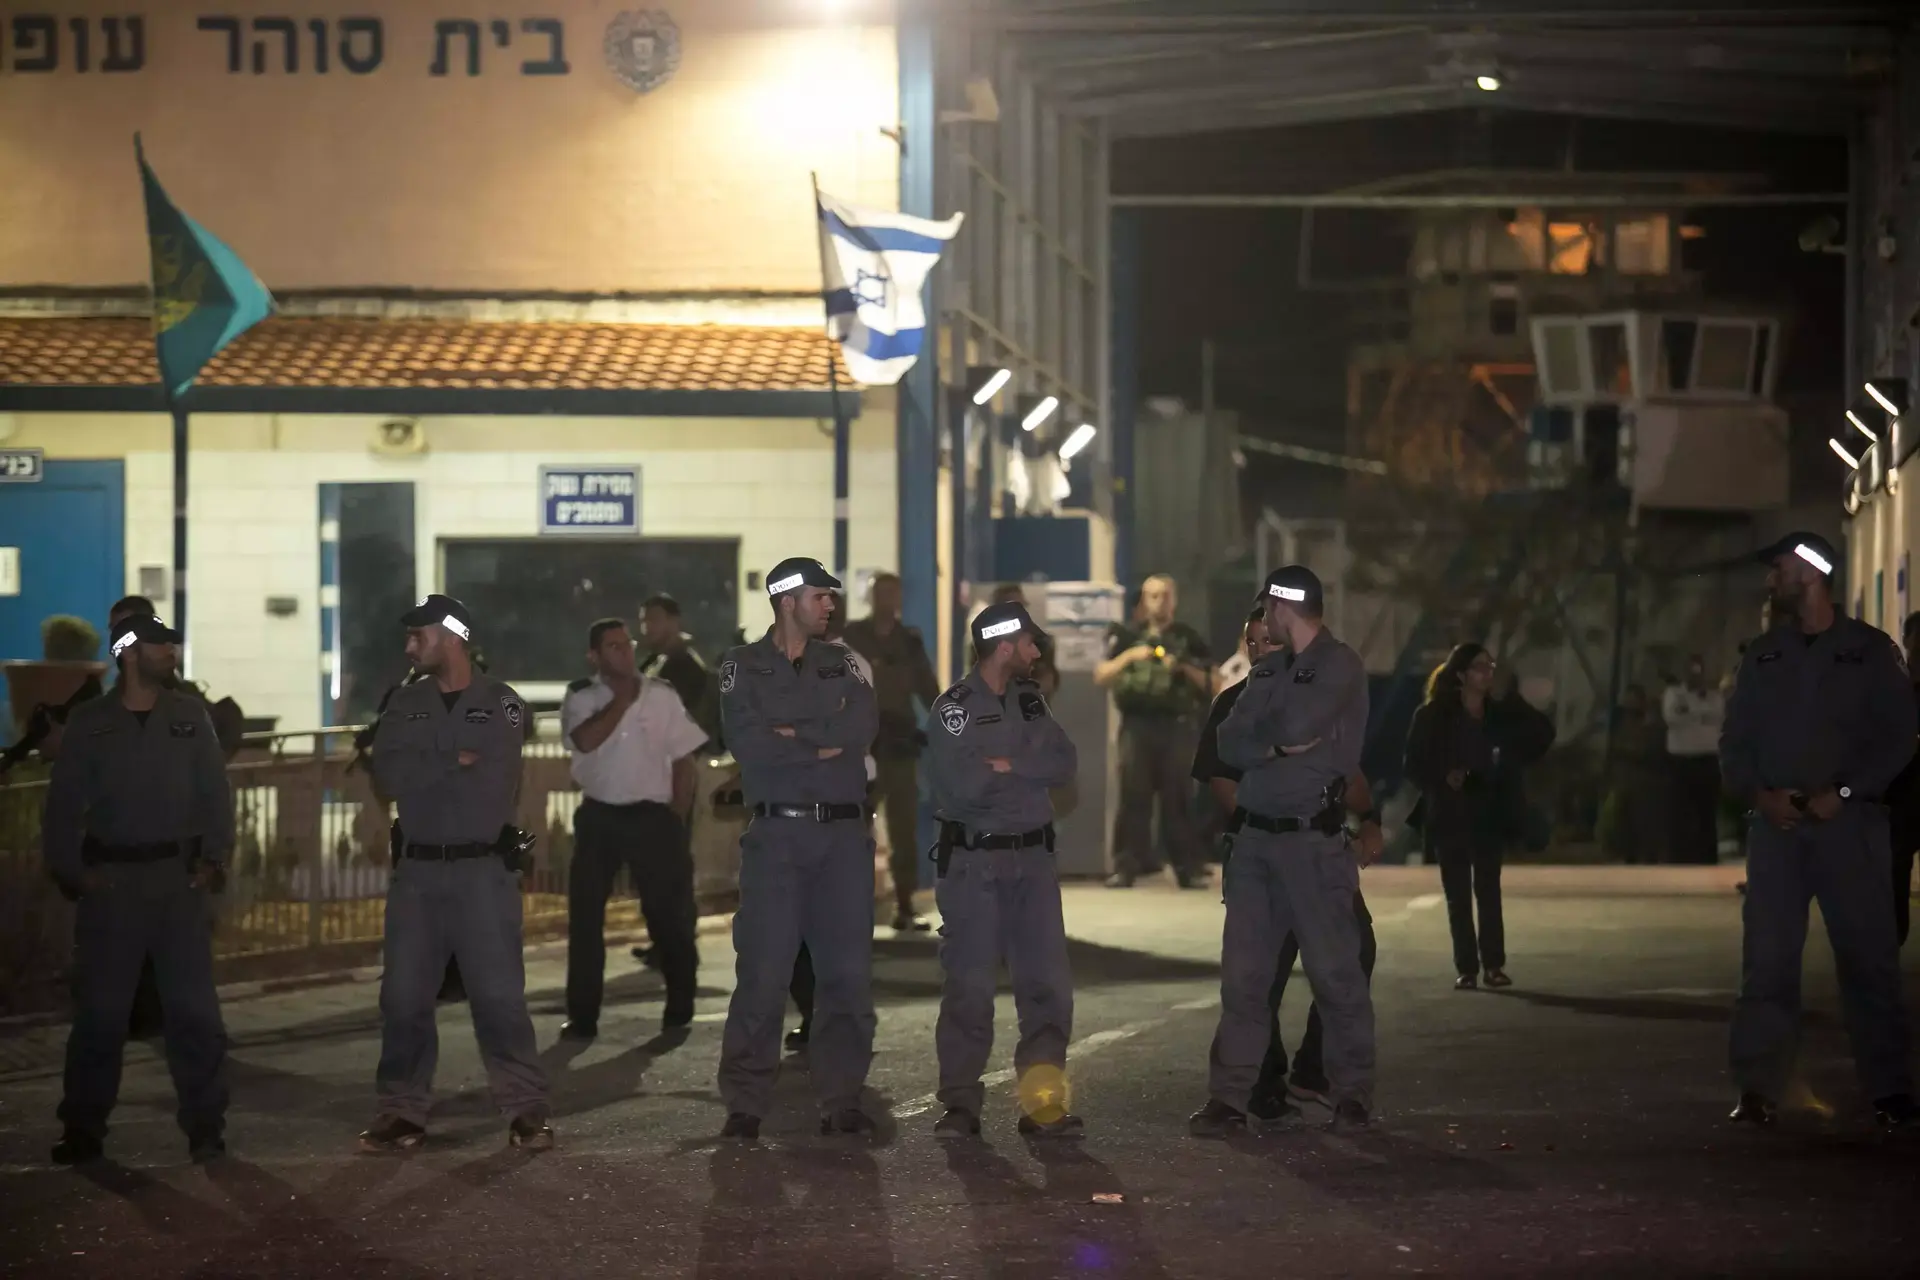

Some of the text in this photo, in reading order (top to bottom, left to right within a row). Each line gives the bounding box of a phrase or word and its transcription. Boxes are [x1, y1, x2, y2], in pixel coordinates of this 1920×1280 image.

[0, 14, 571, 76] בית סוהר עופ
[983, 619, 1015, 634] POLE
